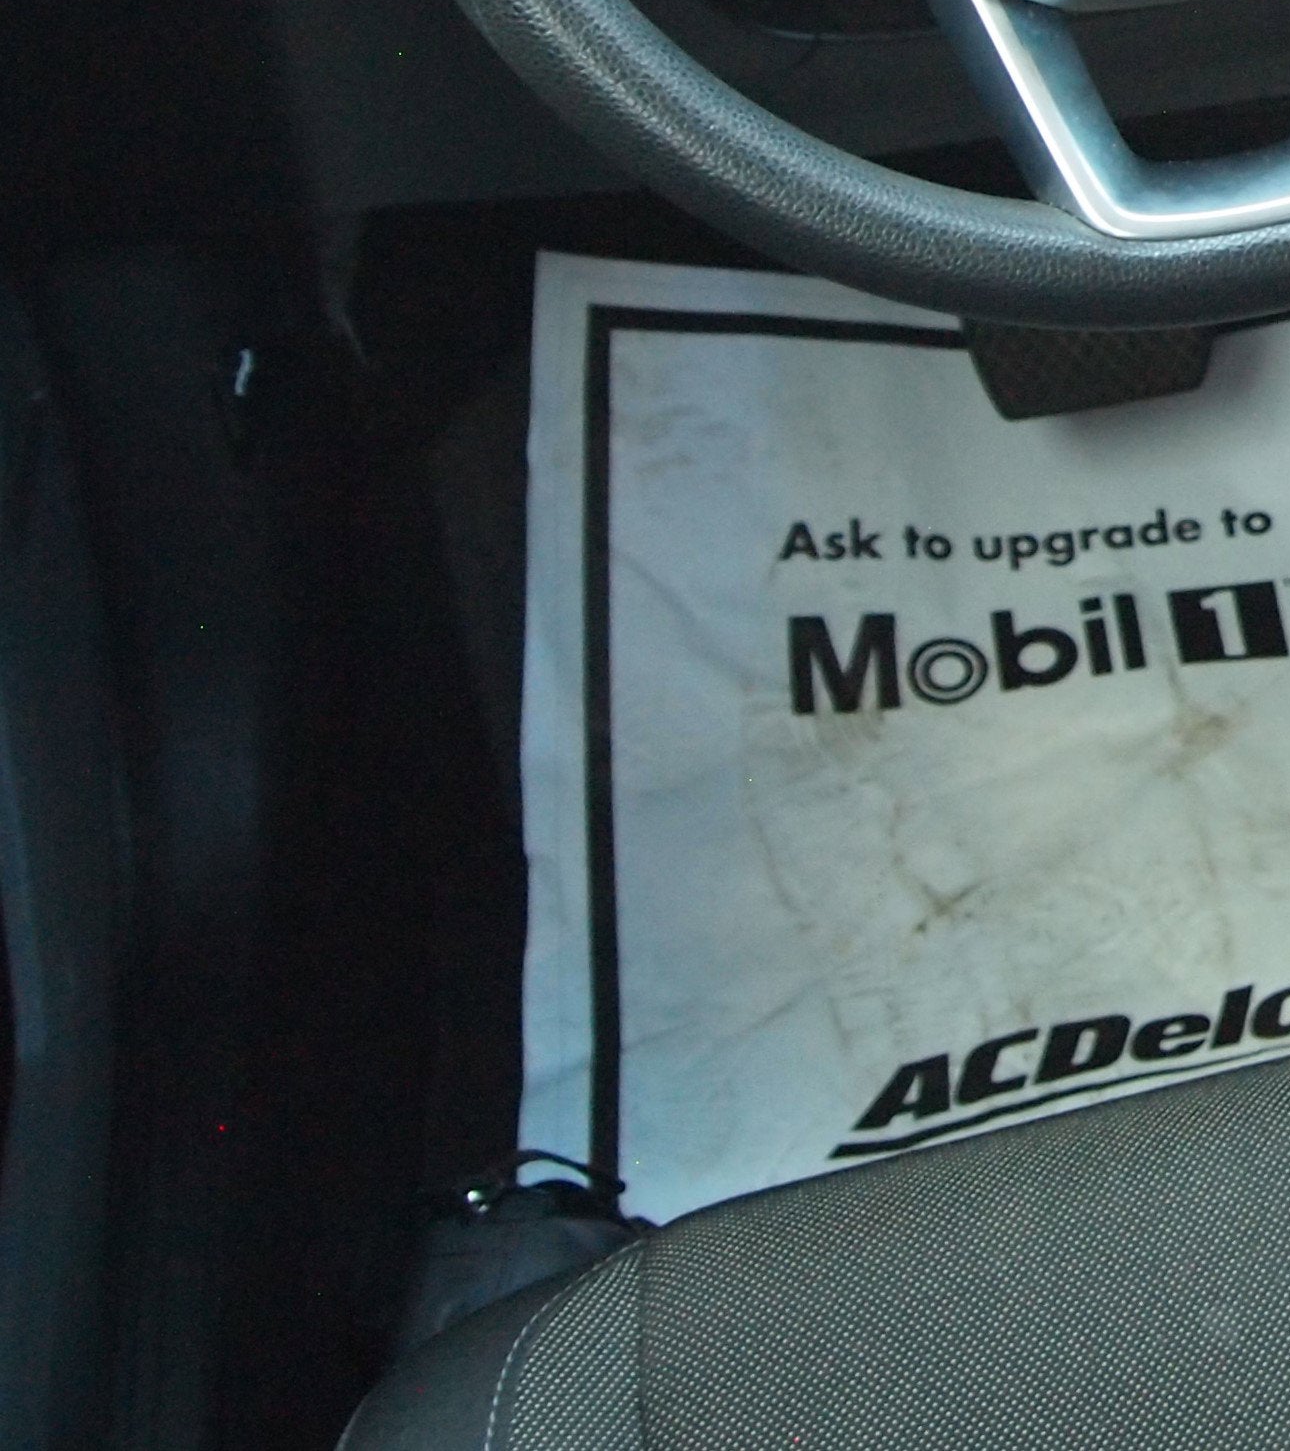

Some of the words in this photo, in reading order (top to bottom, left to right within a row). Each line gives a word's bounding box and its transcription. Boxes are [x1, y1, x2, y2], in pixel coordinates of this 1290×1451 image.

[779, 517, 882, 562] Ask
[905, 525, 953, 561] to
[972, 509, 1202, 571] upgrade
[1222, 507, 1274, 539] to
[788, 592, 1148, 716] Mobil
